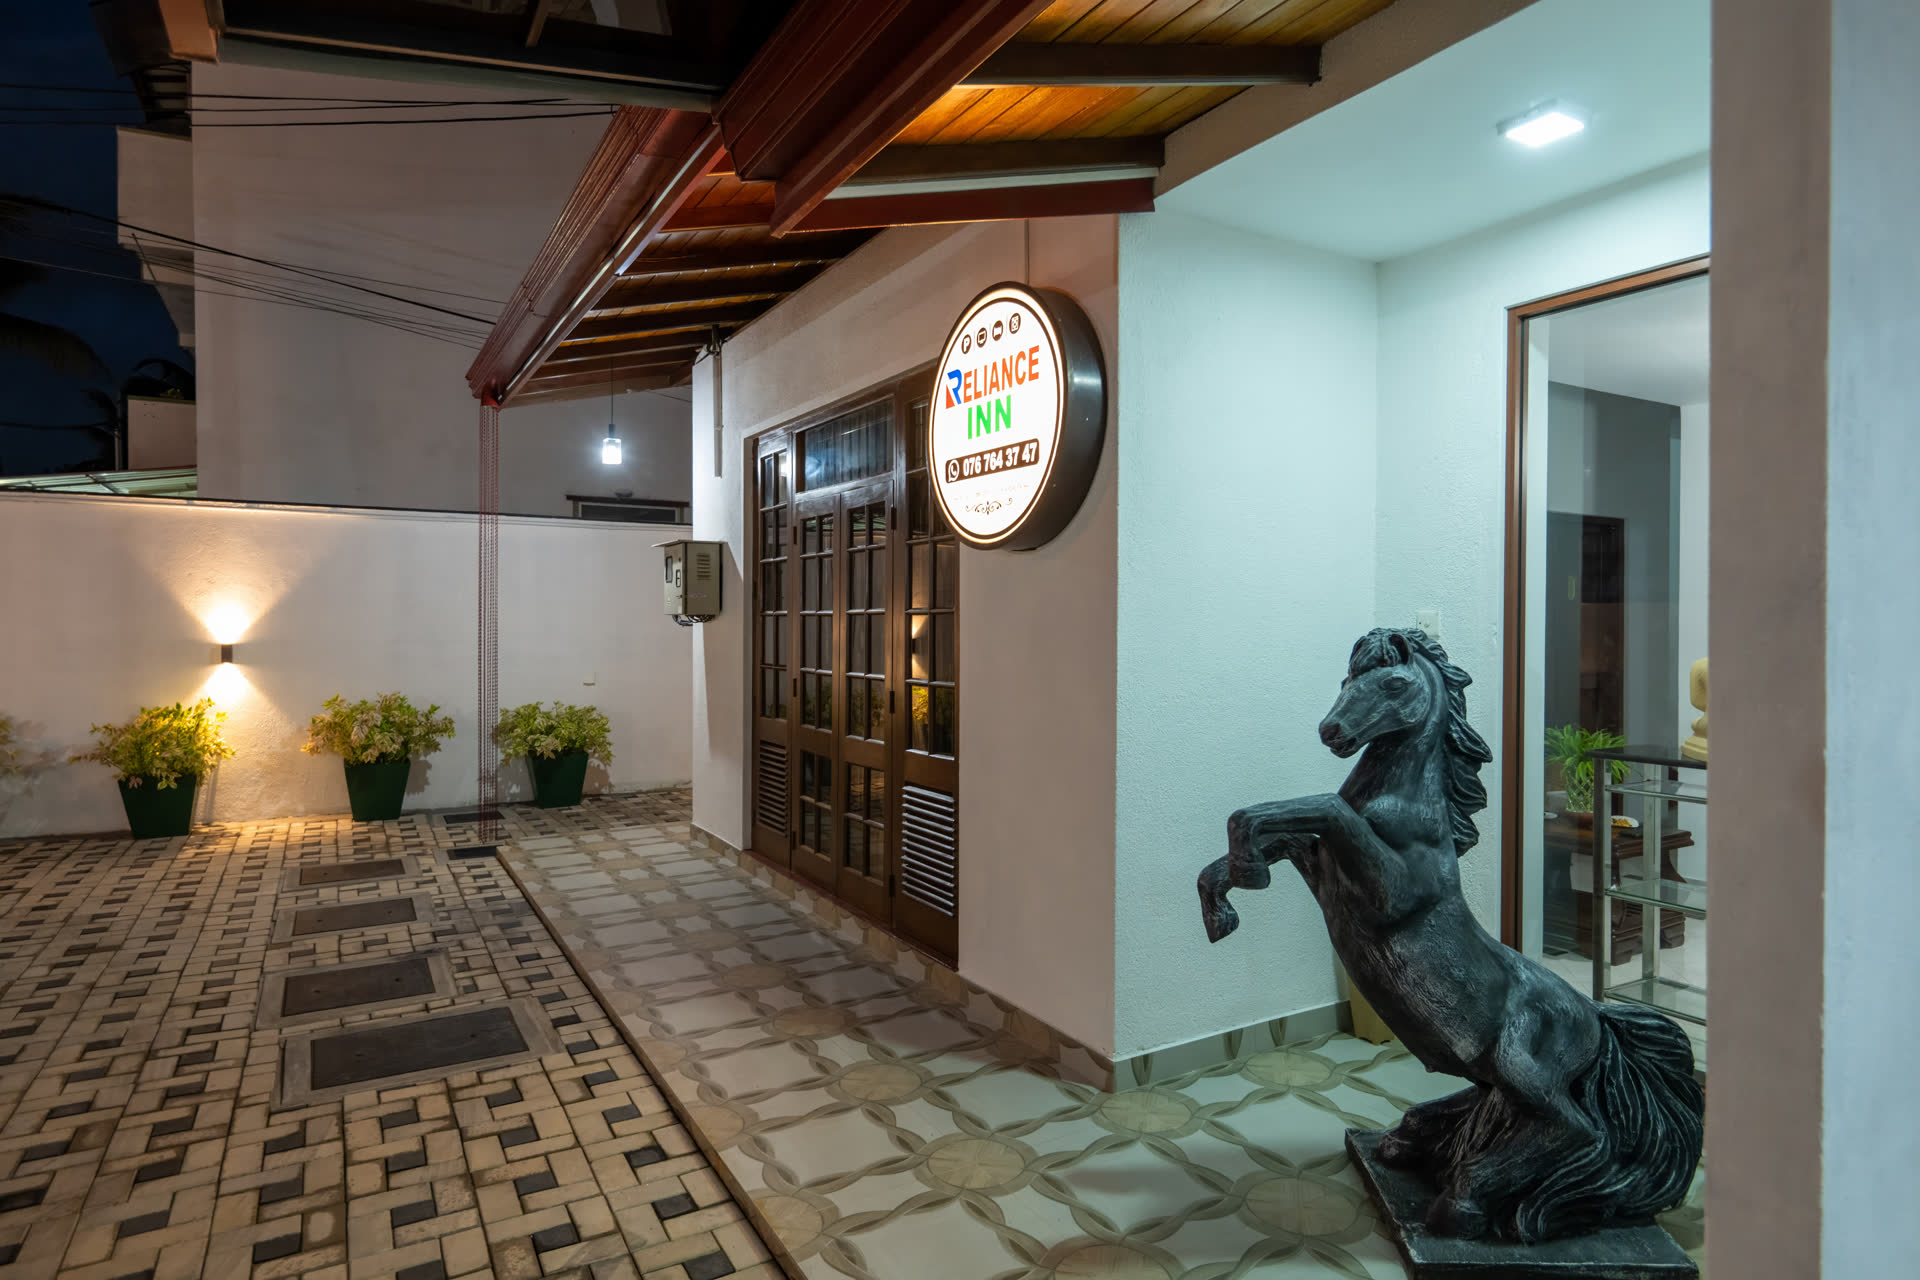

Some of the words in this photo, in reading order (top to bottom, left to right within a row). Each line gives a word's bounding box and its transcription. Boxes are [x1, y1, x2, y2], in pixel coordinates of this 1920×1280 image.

[946, 345, 1039, 409] RELIANCE
[968, 395, 1011, 439] INN
[963, 456, 981, 476] 076
[984, 450, 1003, 472] 764
[1006, 446, 1020, 467] 37
[1022, 442, 1037, 463] 47
